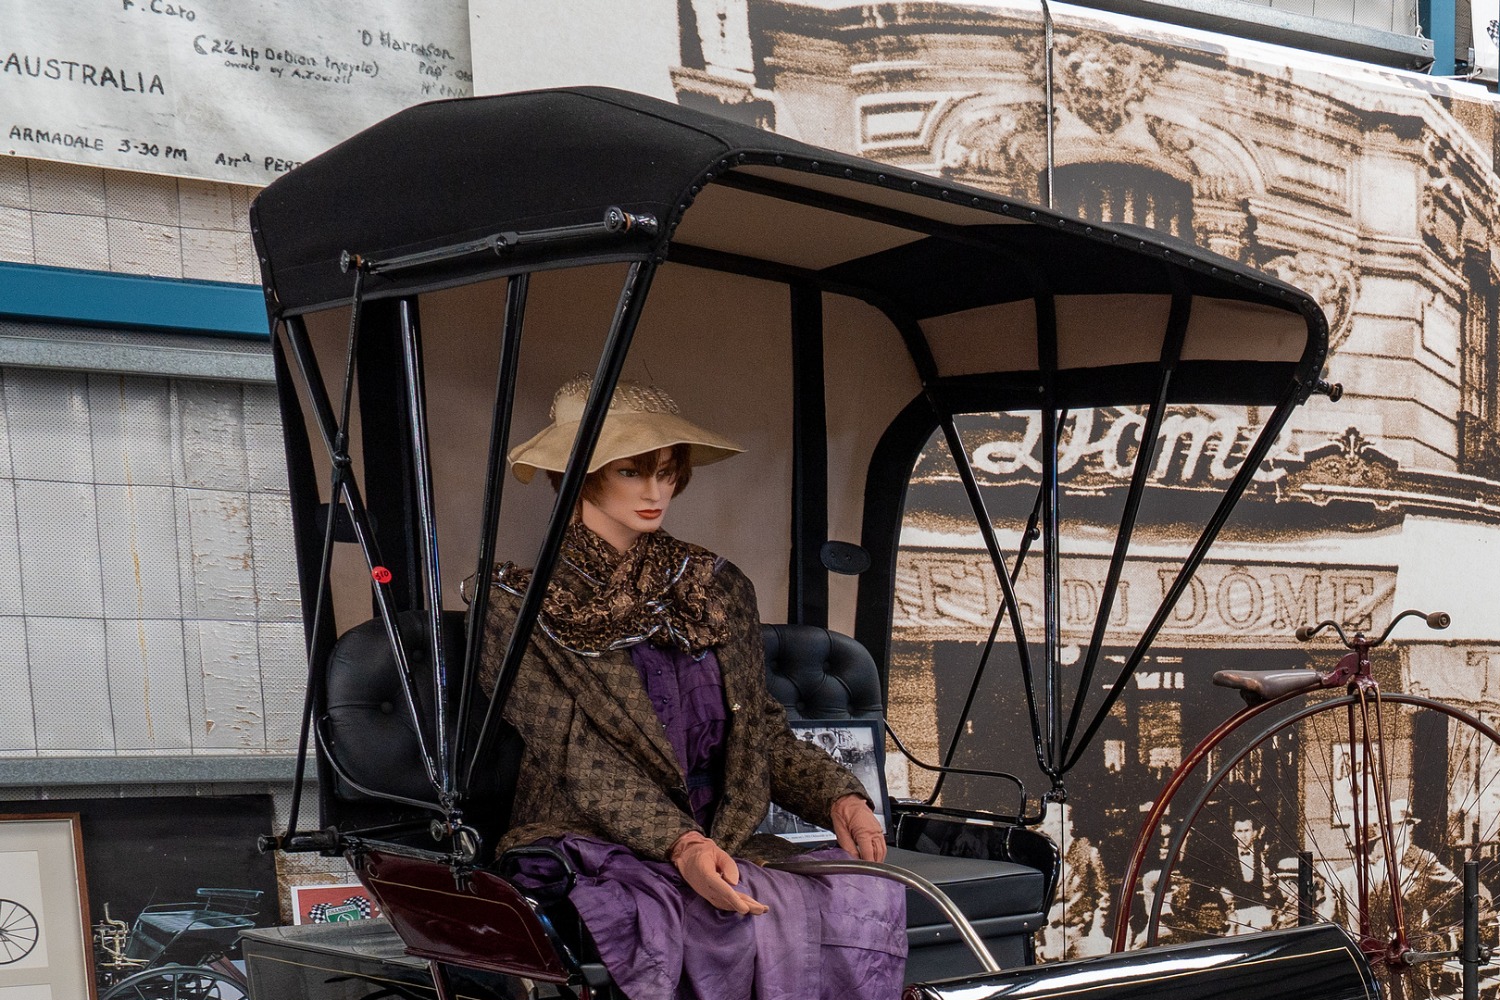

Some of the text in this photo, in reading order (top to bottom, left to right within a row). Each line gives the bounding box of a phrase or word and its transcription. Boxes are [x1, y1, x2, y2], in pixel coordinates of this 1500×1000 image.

[150, 0, 196, 22] Caro
[9, 125, 104, 151] ARMADALE
[117, 139, 160, 158] 3-30
[164, 146, 188, 162] PM
[1157, 565, 1375, 633] DÔME
